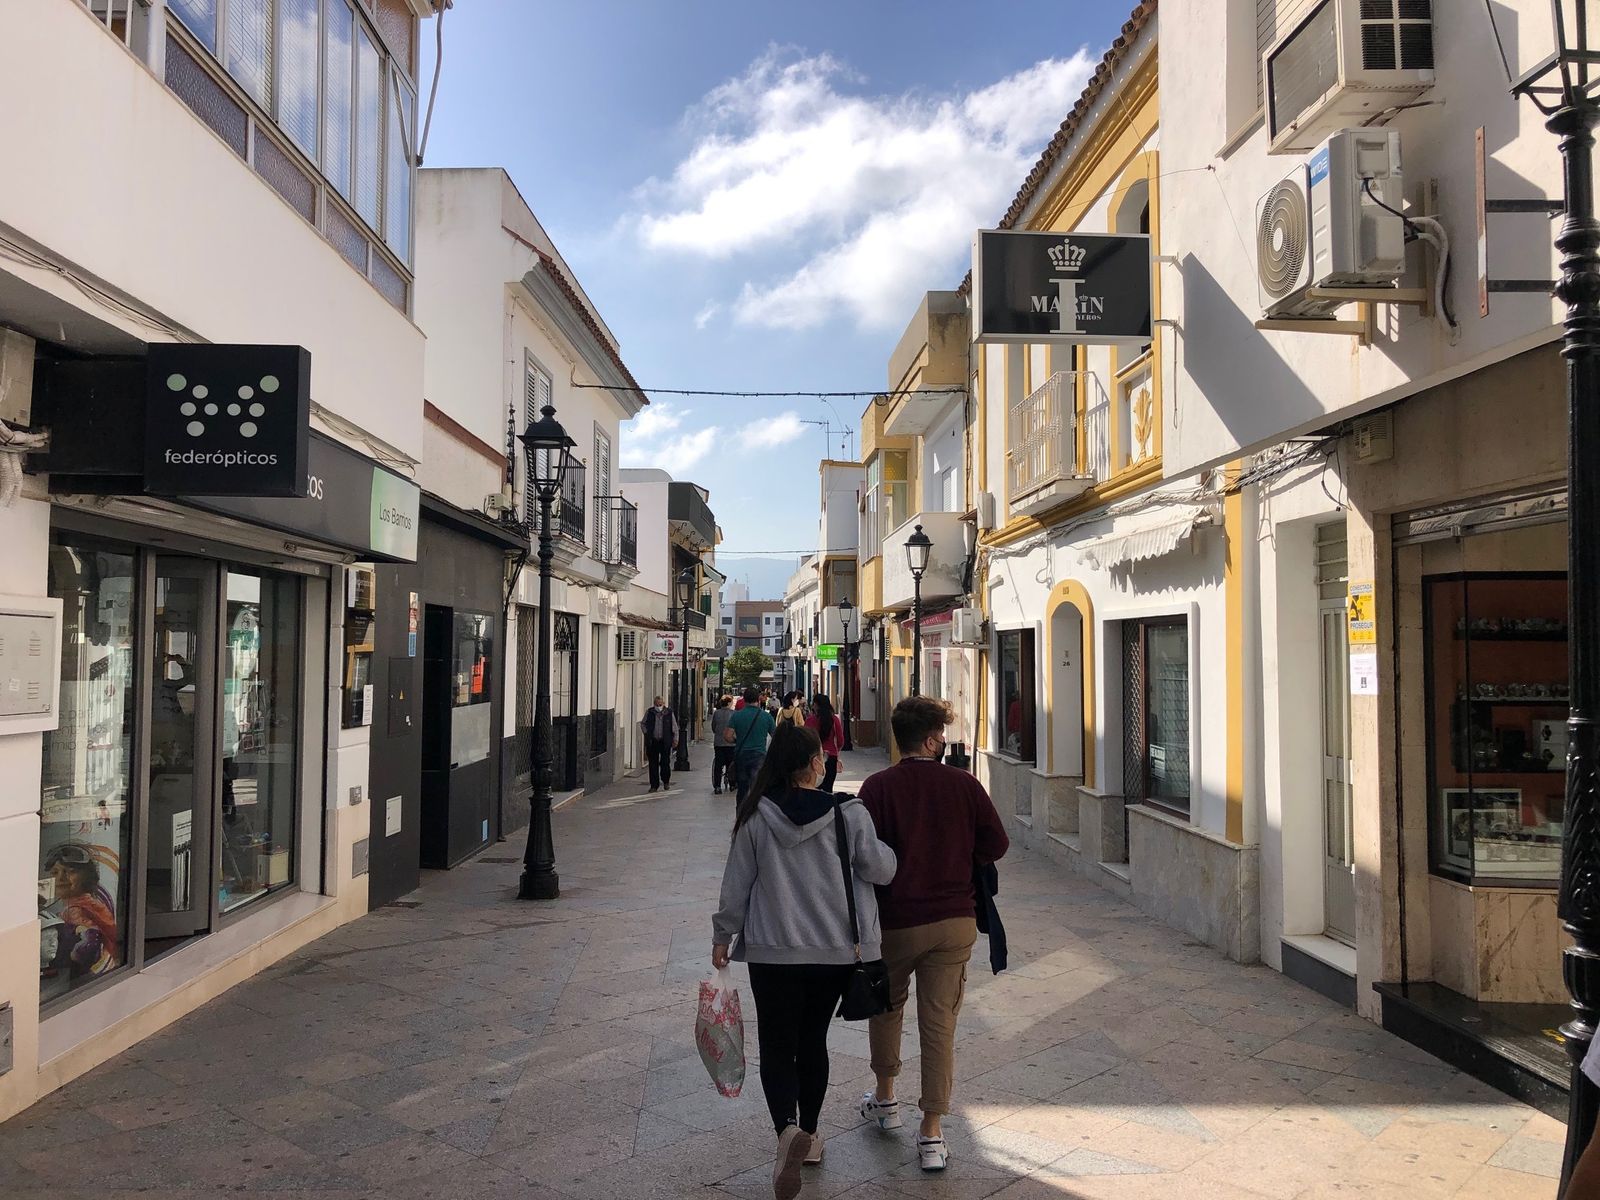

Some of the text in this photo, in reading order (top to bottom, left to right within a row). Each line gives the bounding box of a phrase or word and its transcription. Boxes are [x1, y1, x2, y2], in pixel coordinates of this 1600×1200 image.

[164, 448, 278, 468] federópticos
[379, 502, 412, 530] Los Barrios
[1350, 621, 1374, 630] PROSEGUR
